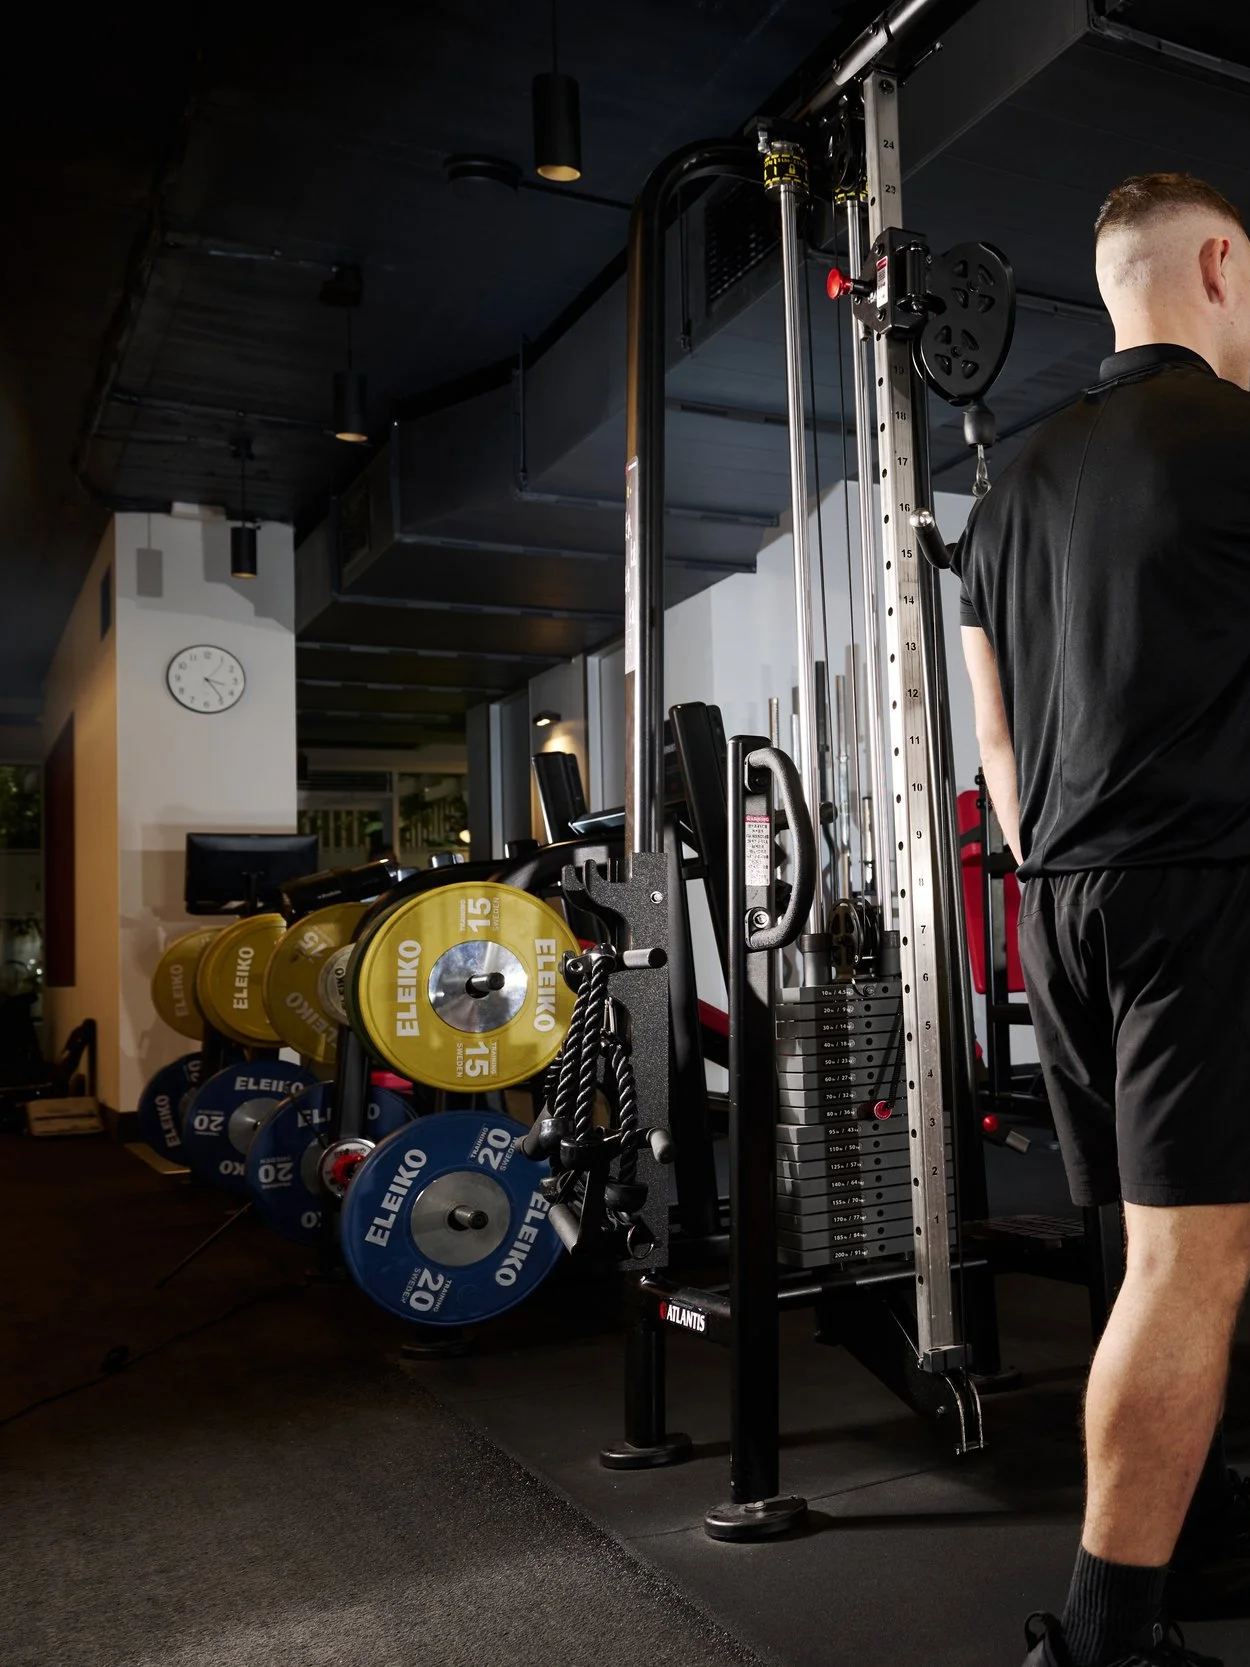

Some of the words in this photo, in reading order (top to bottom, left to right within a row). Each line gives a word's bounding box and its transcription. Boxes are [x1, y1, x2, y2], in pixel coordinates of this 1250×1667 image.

[883, 140, 895, 150] 24
[885, 184, 896, 195] 23
[896, 411, 907, 421] 18
[898, 457, 908, 466] 17
[900, 503, 911, 512] 16
[902, 550, 913, 559] 15
[904, 596, 915, 605] 14
[906, 642, 917, 651] 13
[908, 688, 919, 698] 12
[910, 736, 920, 745] 11
[912, 783, 923, 792] 10
[916, 830, 922, 839] 9
[468, 898, 491, 933] 15
[920, 925, 926, 934] 7
[233, 947, 255, 1010] ELEIKO
[922, 972, 929, 981] 6
[396, 940, 422, 1036] ELEIKO
[534, 938, 556, 1032] ELEIKO
[170, 964, 189, 1017] ELEIKO
[925, 1021, 931, 1030] 5
[466, 1040, 490, 1077] 15
[928, 1069, 934, 1078] 4
[154, 1095, 182, 1148] ELEIKO
[194, 1115, 225, 1132] 20
[930, 1118, 936, 1127] 3
[471, 1127, 489, 1159] TRAINING
[478, 1128, 511, 1170] 20
[258, 1162, 293, 1183] 20
[932, 1166, 938, 1176] 2
[365, 1149, 427, 1247] ELEIKO
[934, 1216, 939, 1224] 1
[495, 1191, 551, 1287] ELEIKO
[400, 1268, 421, 1304] SWEDEN
[410, 1268, 444, 1312] 20
[434, 1280, 452, 1312] TRAINING
[667, 1304, 705, 1332] ATLANTIS
